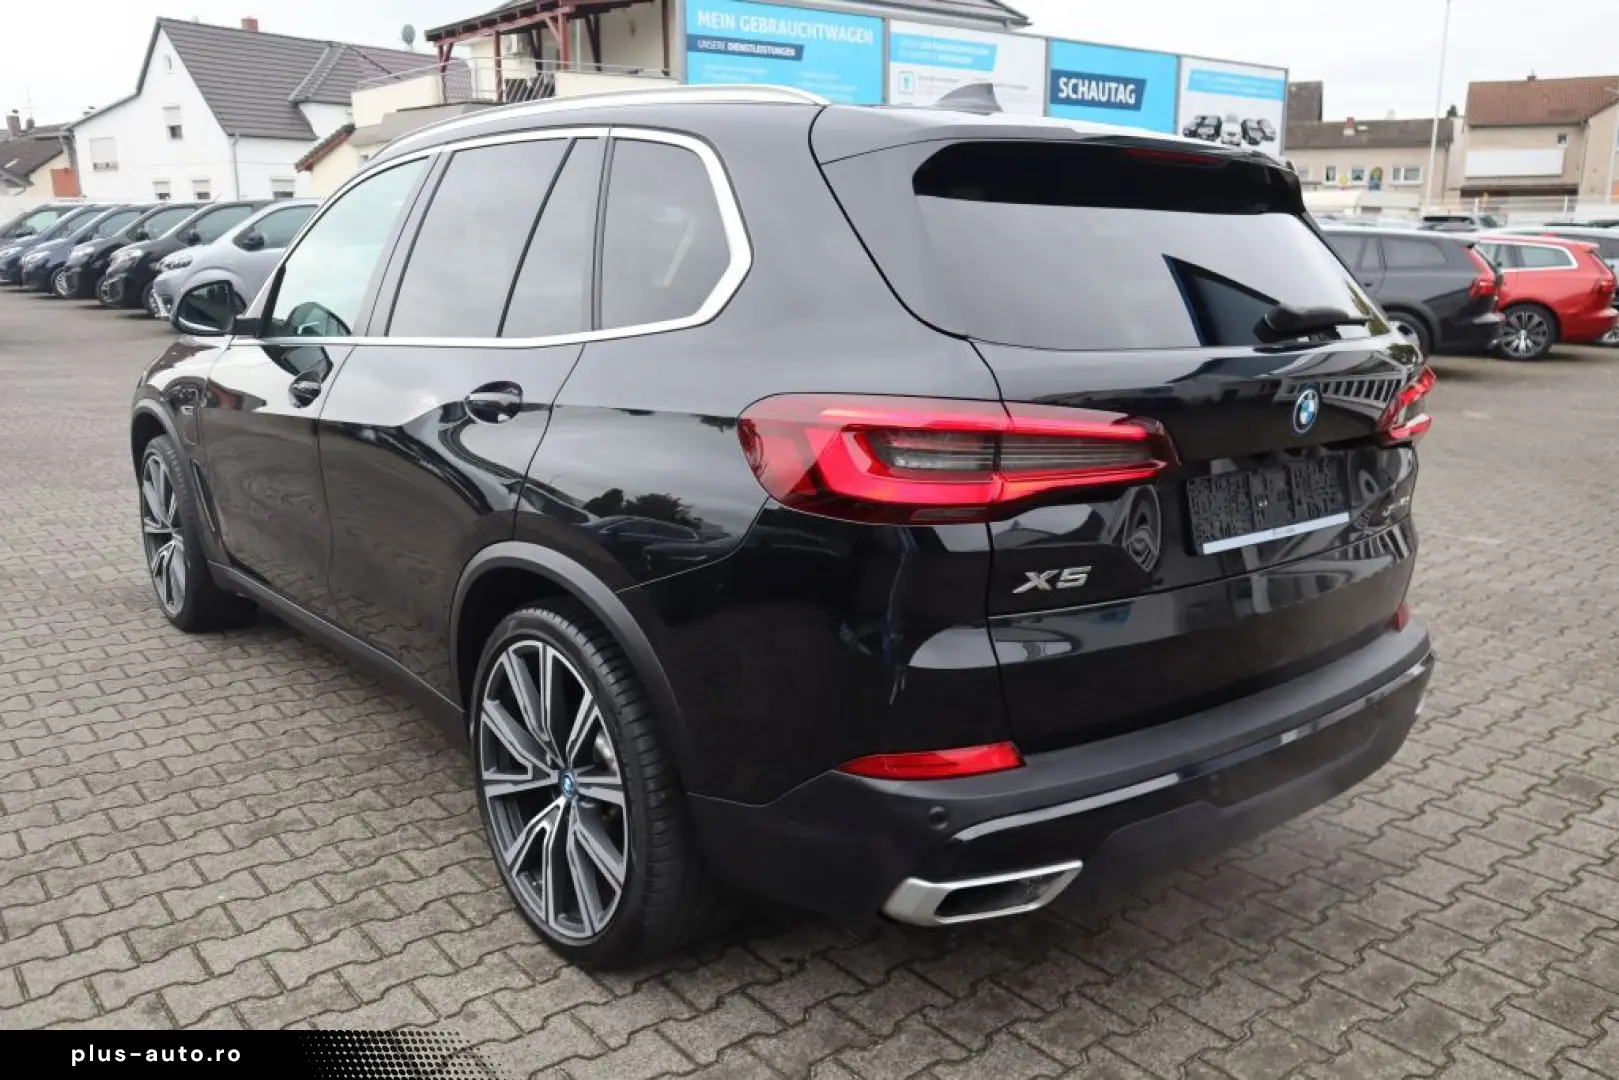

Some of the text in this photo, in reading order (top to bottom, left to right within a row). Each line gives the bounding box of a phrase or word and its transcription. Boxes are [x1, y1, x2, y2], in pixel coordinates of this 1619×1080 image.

[697, 11, 874, 45] MEIN GEBRAUCHTWAGEN
[697, 39, 796, 57] UNSERE DIENSTLEISTUNGEN
[1057, 77, 1136, 105] SCHAUTAG
[1012, 565, 1092, 594] X5
